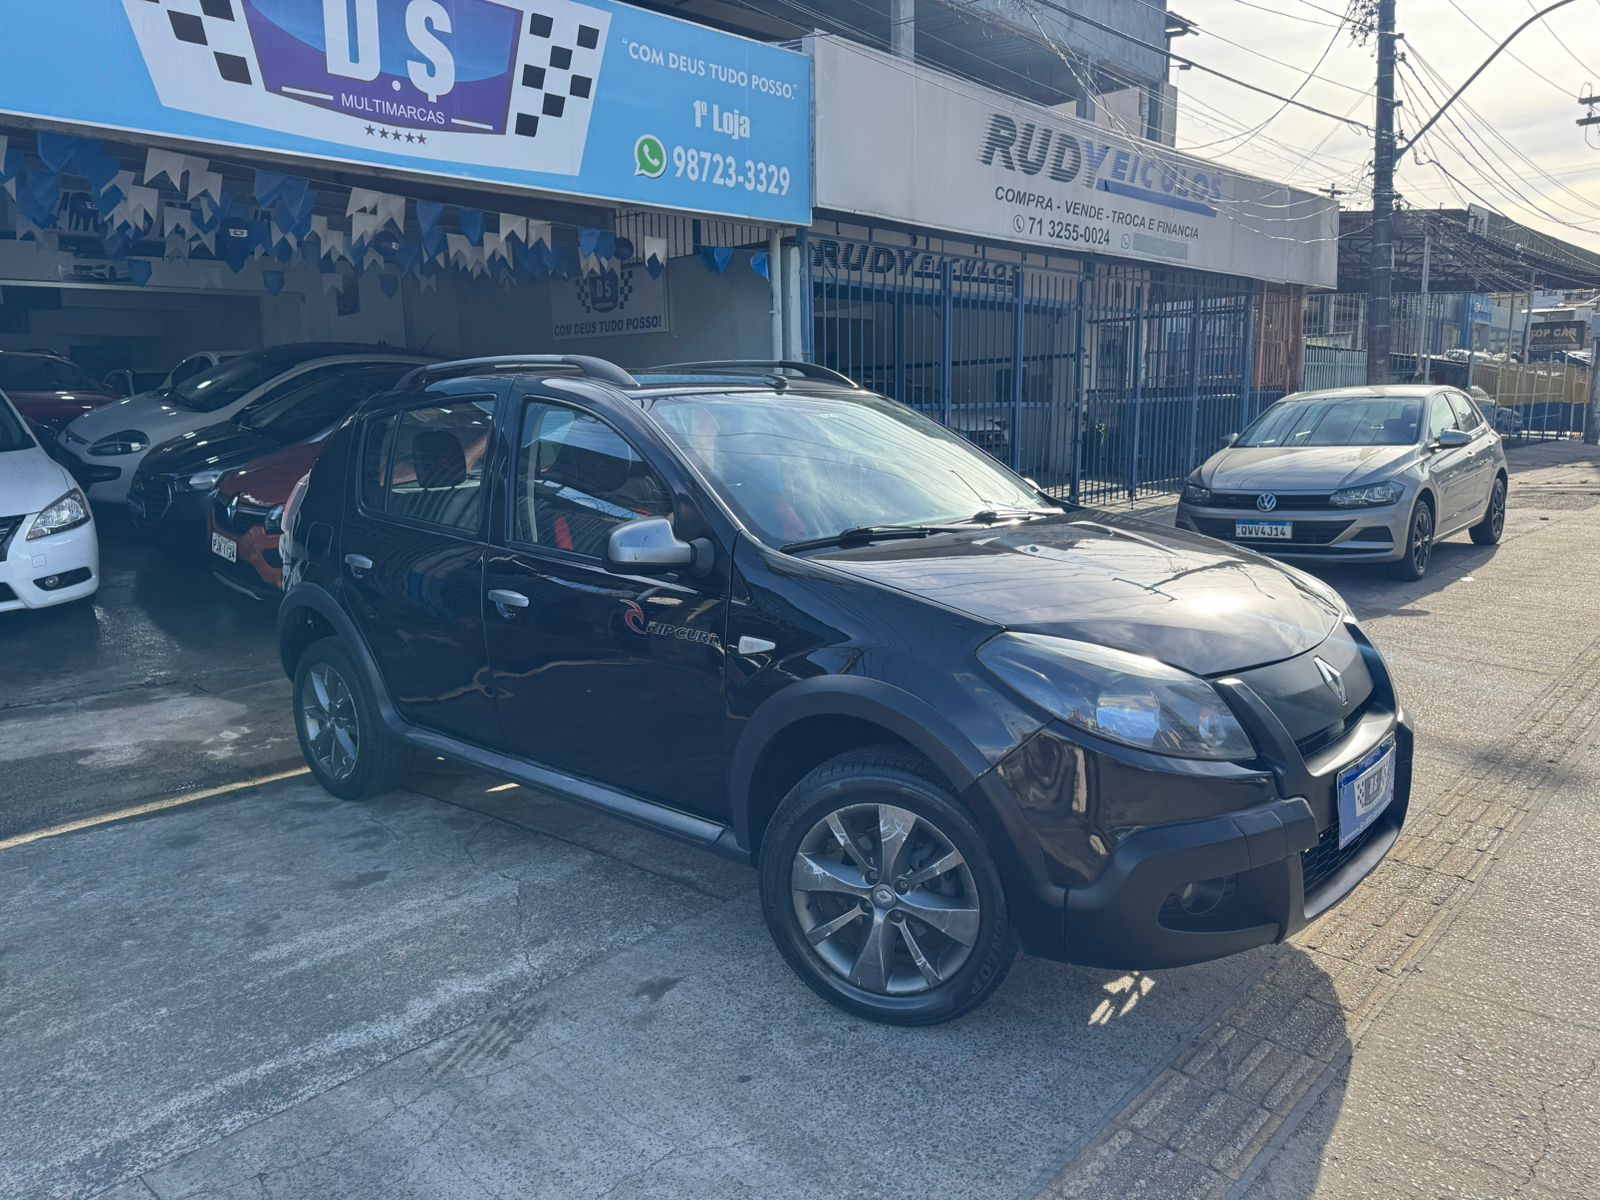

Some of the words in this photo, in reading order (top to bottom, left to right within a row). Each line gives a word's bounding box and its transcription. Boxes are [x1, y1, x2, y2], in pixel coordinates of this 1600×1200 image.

[668, 52, 705, 77] DEUS
[709, 63, 748, 88] TUDO
[341, 92, 445, 125] MULTIMARCAS
[712, 104, 750, 140] Loja
[672, 146, 791, 196] 98723-3329
[995, 185, 1054, 212] COMPRA
[1065, 200, 1104, 221] VENDE
[1111, 210, 1146, 229] TROCA
[1148, 218, 1155, 231] E
[1156, 220, 1199, 239] FINANCIA
[1028, 216, 1043, 236] 71
[1047, 220, 1110, 246] 3255-0024
[554, 325, 572, 337] COM
[574, 321, 597, 335] DEUS
[600, 319, 623, 333] TUDO
[626, 315, 662, 330] POSSO!
[1553, 327, 1577, 338] CAR
